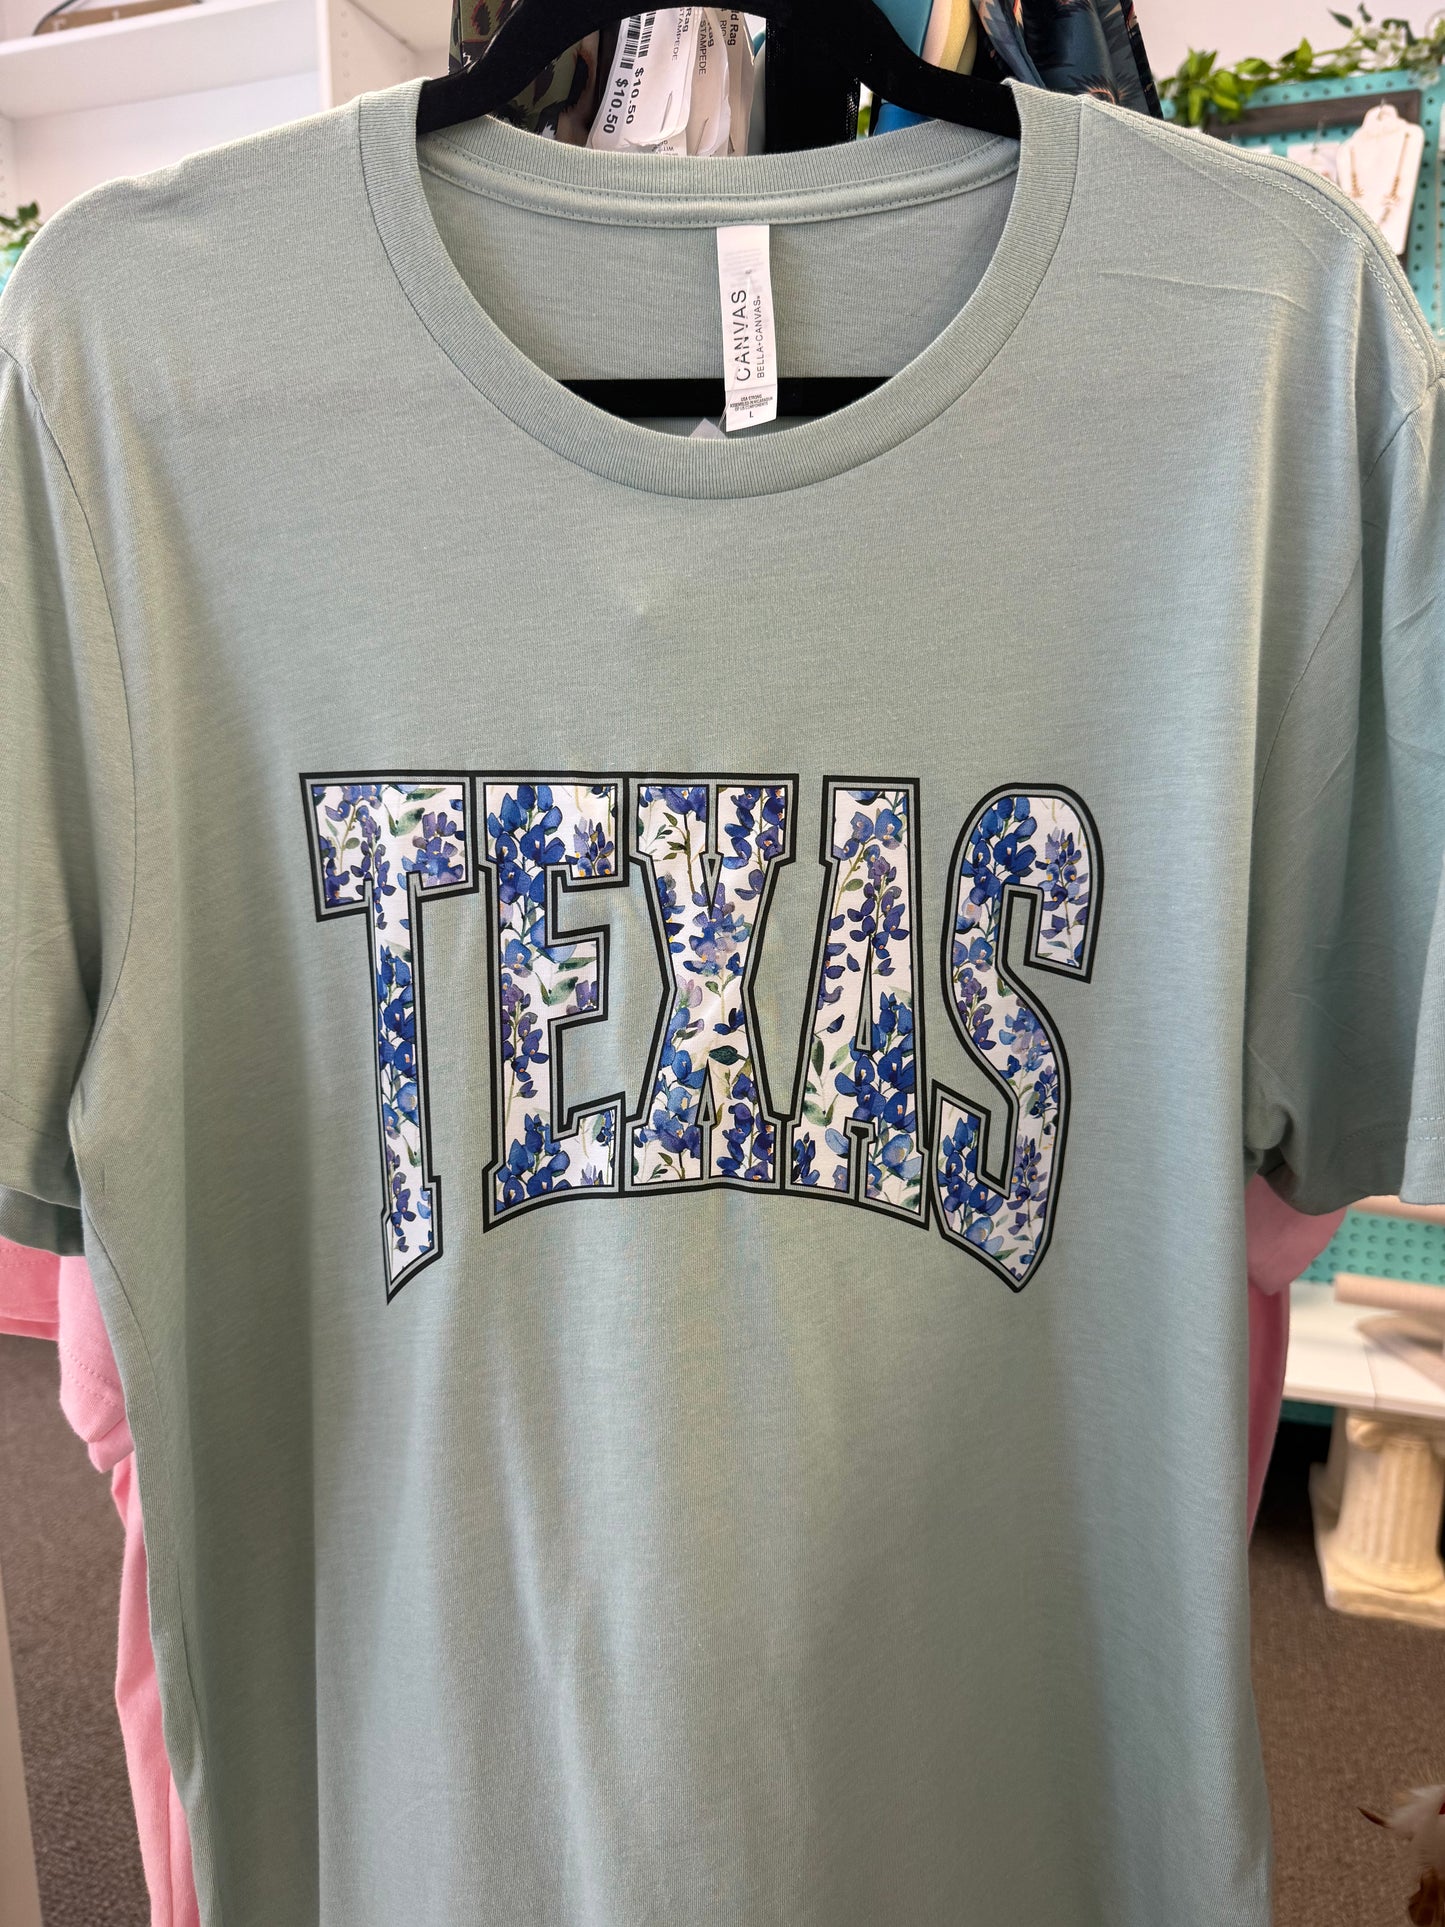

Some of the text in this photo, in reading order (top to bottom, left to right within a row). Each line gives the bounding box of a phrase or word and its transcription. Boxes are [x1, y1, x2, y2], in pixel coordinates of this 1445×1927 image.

[699, 20, 707, 75] STAMPEDE
[727, 24, 739, 46] Rag
[603, 78, 629, 133] $10.50
[626, 67, 644, 125] $10.50
[731, 289, 751, 382] CANVAS
[749, 410, 754, 418] L
[300, 771, 1104, 1304] TEXAS
